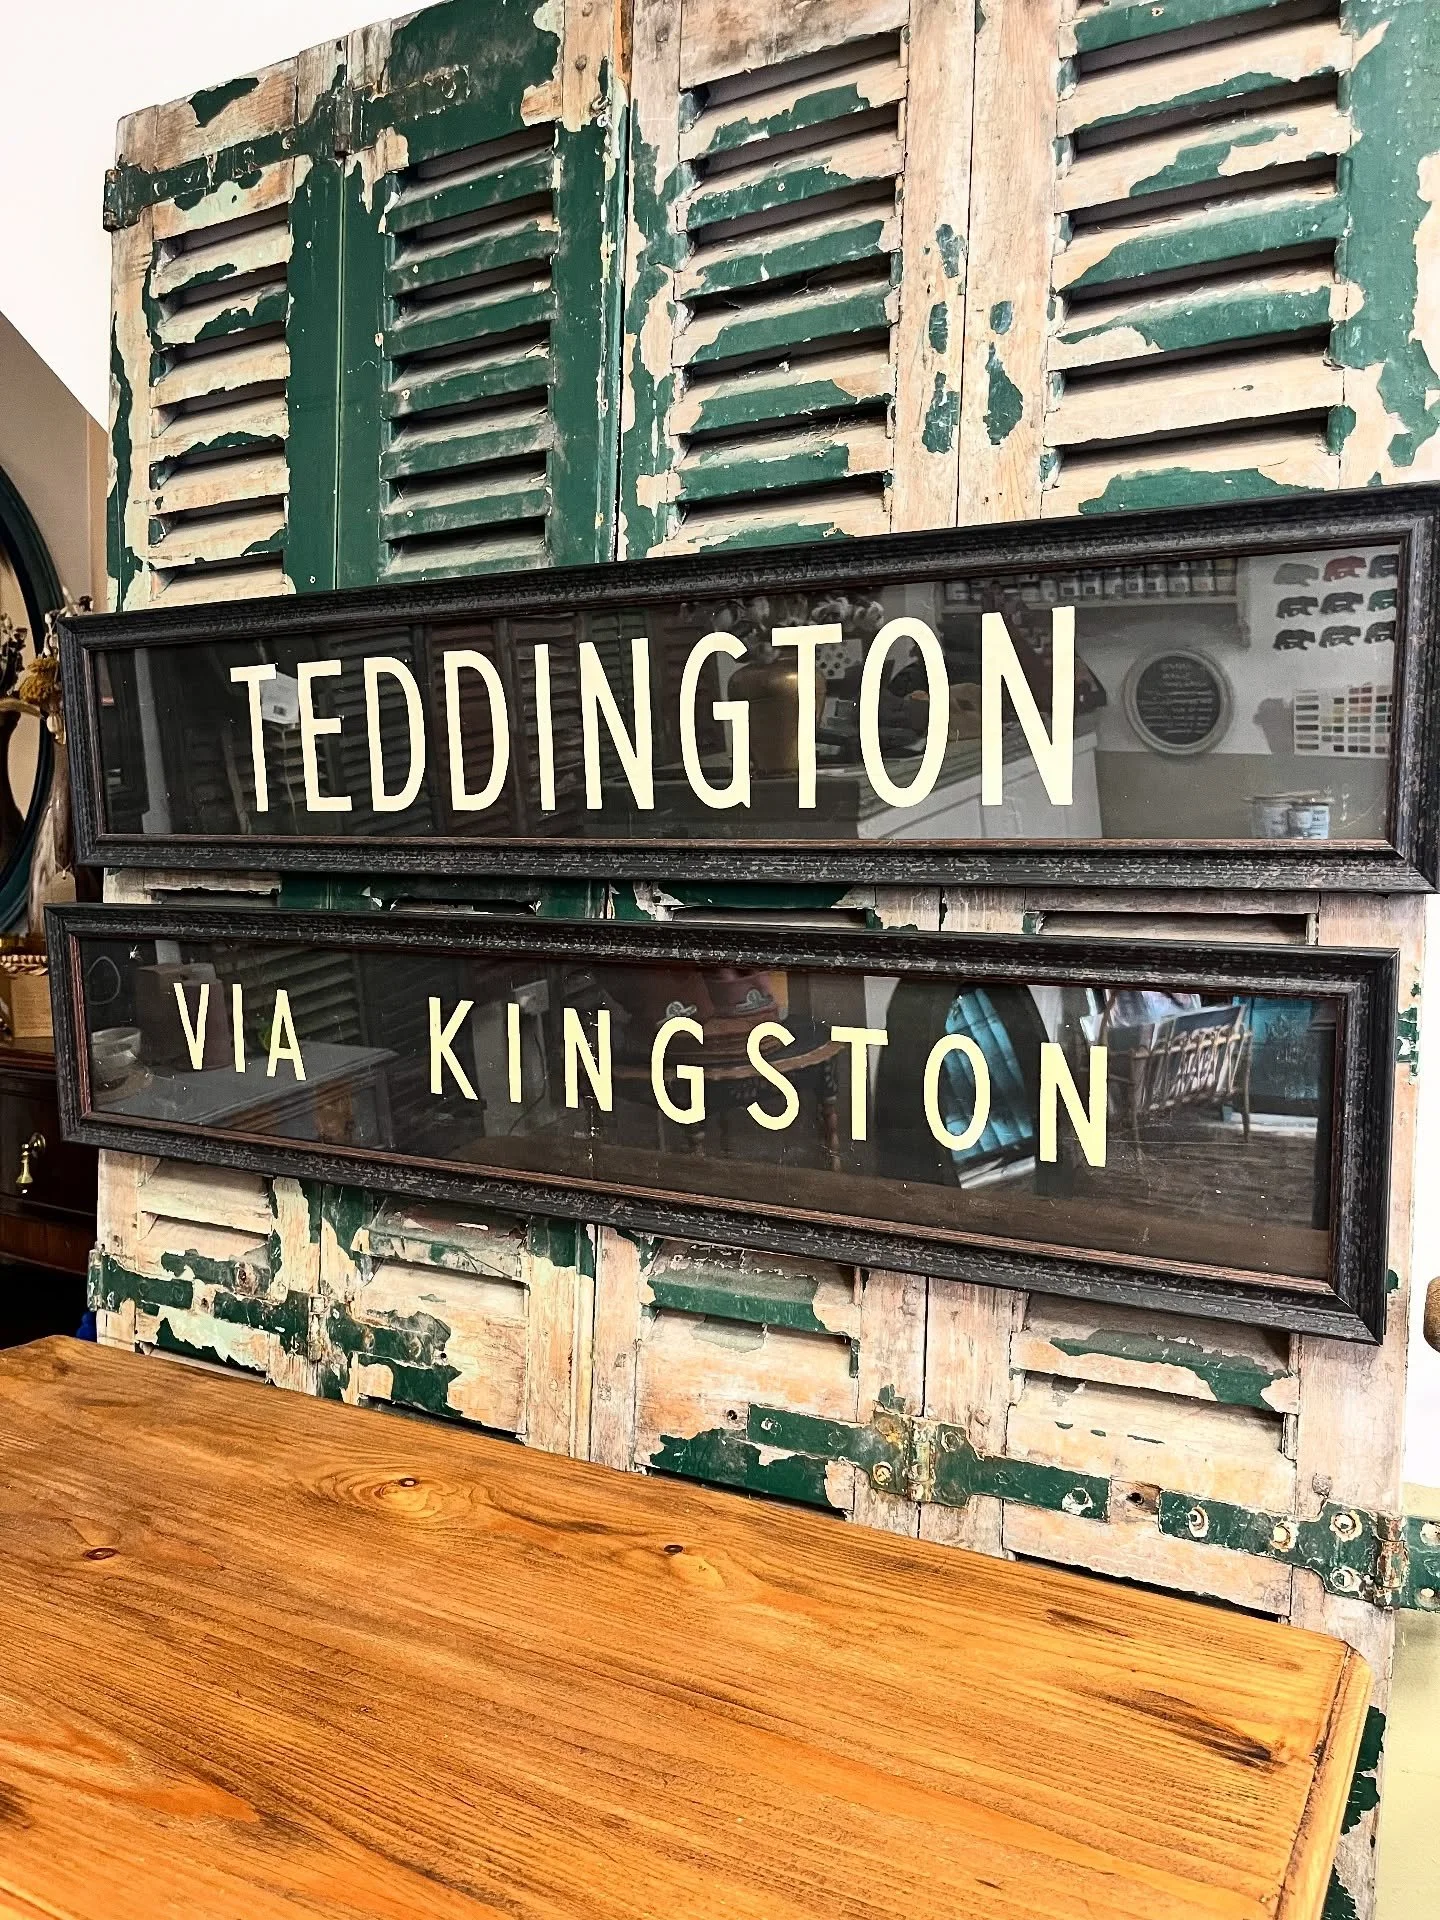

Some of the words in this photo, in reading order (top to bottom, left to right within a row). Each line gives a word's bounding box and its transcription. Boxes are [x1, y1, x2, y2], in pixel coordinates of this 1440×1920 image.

[230, 605, 1075, 812] TEDDINGTON
[173, 982, 307, 1081] VIA
[428, 996, 1108, 1168] KINGSTON
